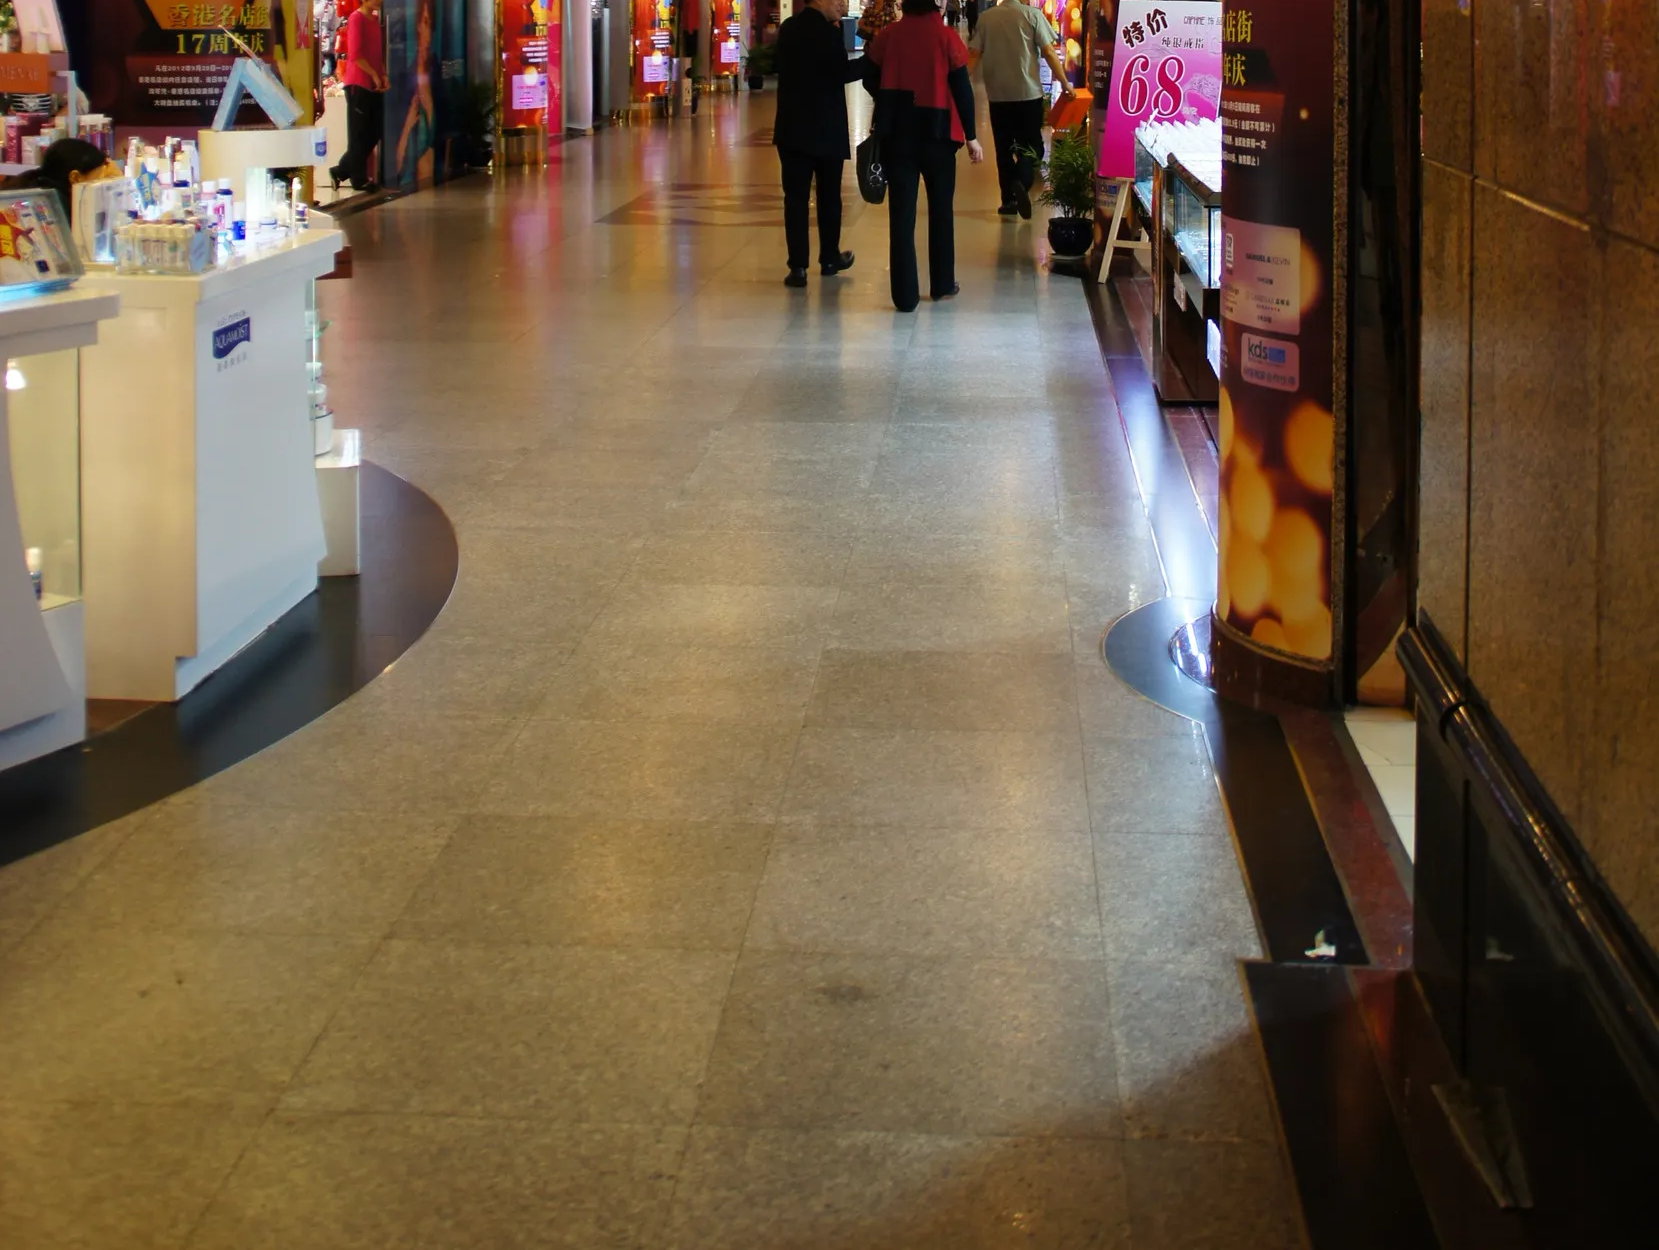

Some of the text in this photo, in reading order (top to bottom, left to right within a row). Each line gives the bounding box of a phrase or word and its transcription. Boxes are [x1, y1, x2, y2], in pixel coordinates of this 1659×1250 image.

[168, 4, 270, 28] 香港名店街
[1122, 8, 1169, 49] 特价
[1223, 10, 1253, 43] 店街
[1119, 54, 1185, 118] 68
[1248, 337, 1268, 361] kds
